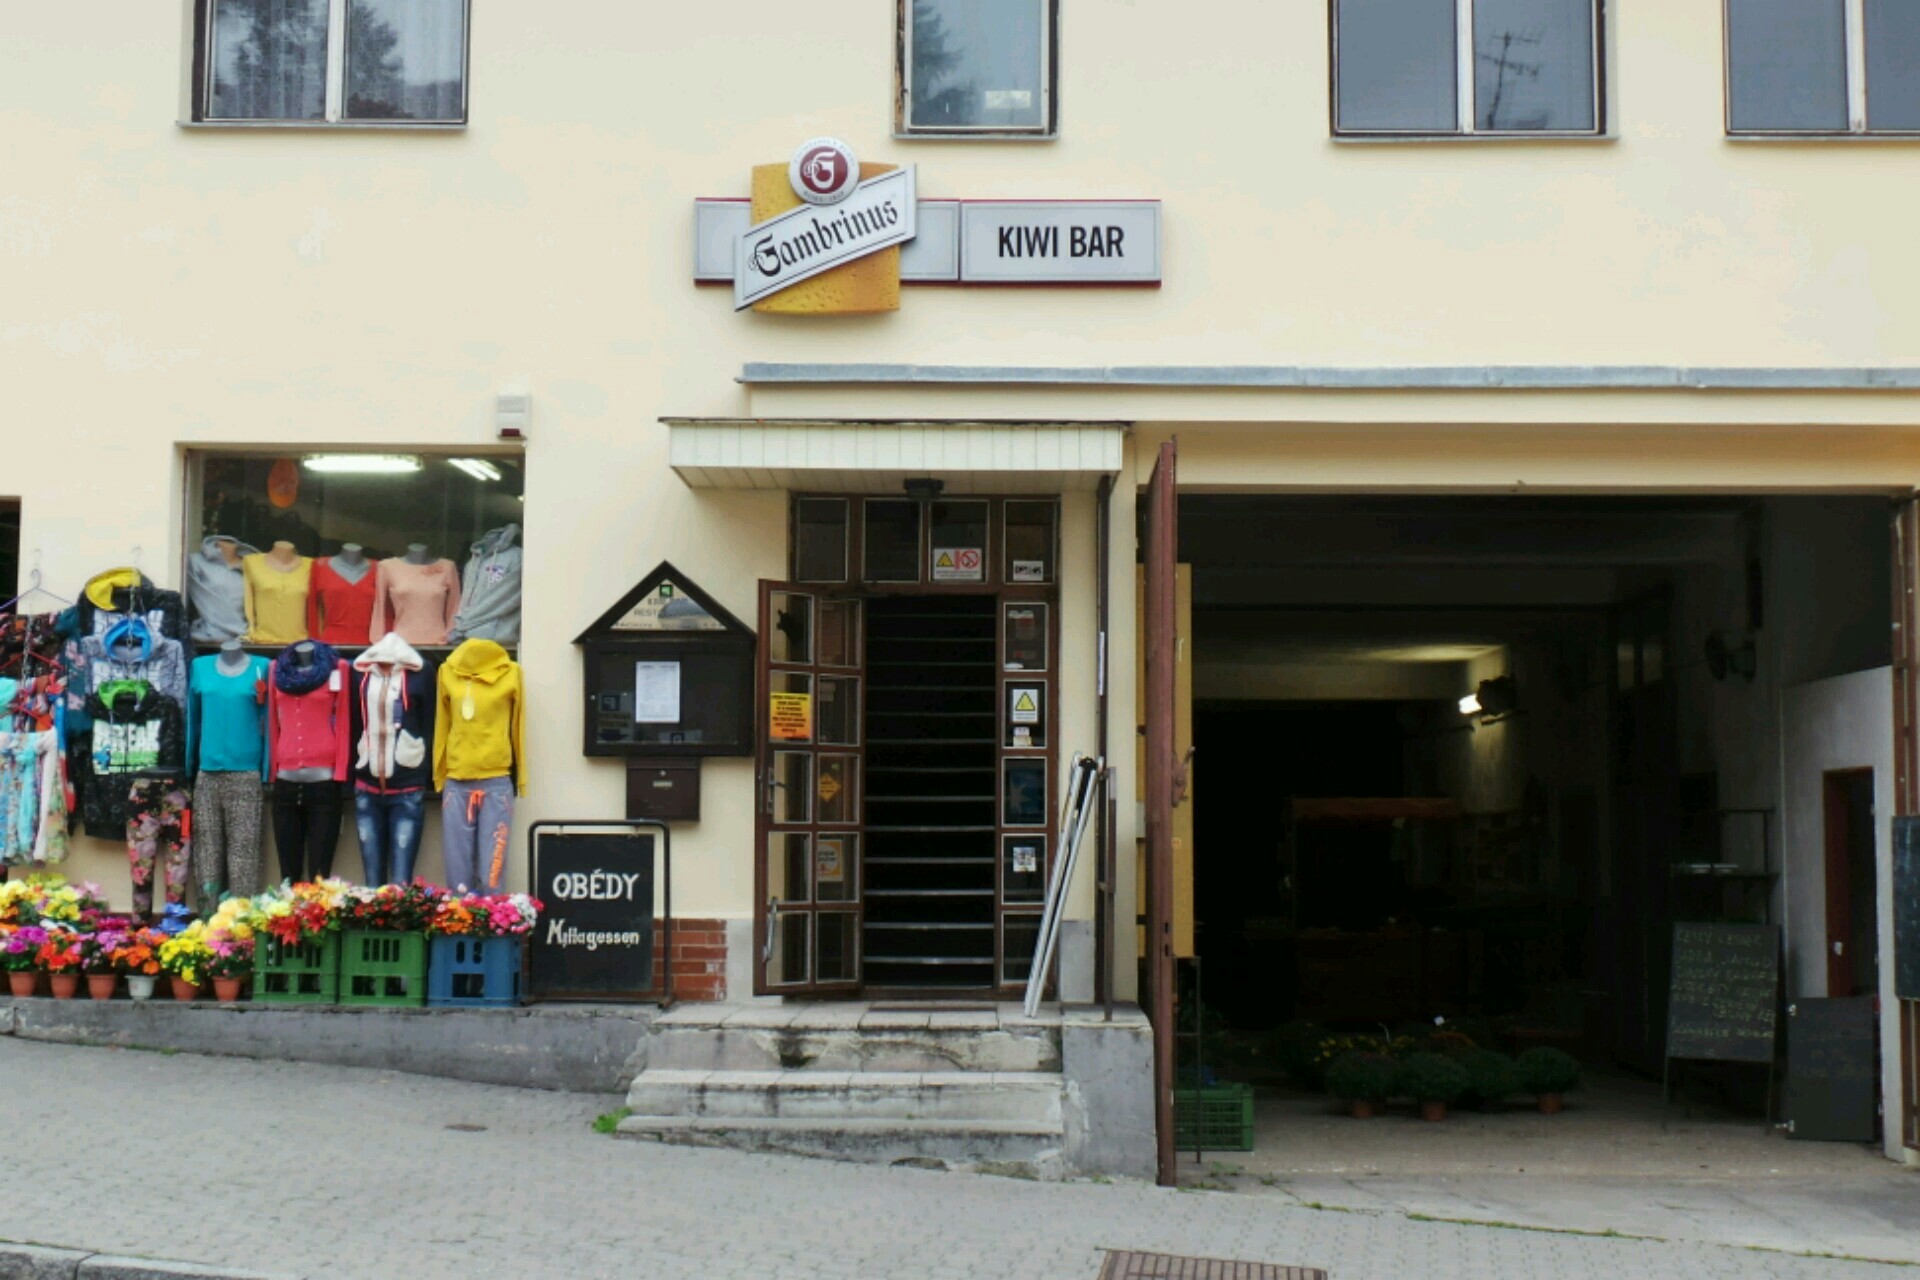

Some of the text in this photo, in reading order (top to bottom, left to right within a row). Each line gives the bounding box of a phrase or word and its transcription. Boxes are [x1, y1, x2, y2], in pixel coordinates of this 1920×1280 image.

[750, 201, 898, 277] Gambrinus
[998, 226, 1125, 258] KIWI BAR
